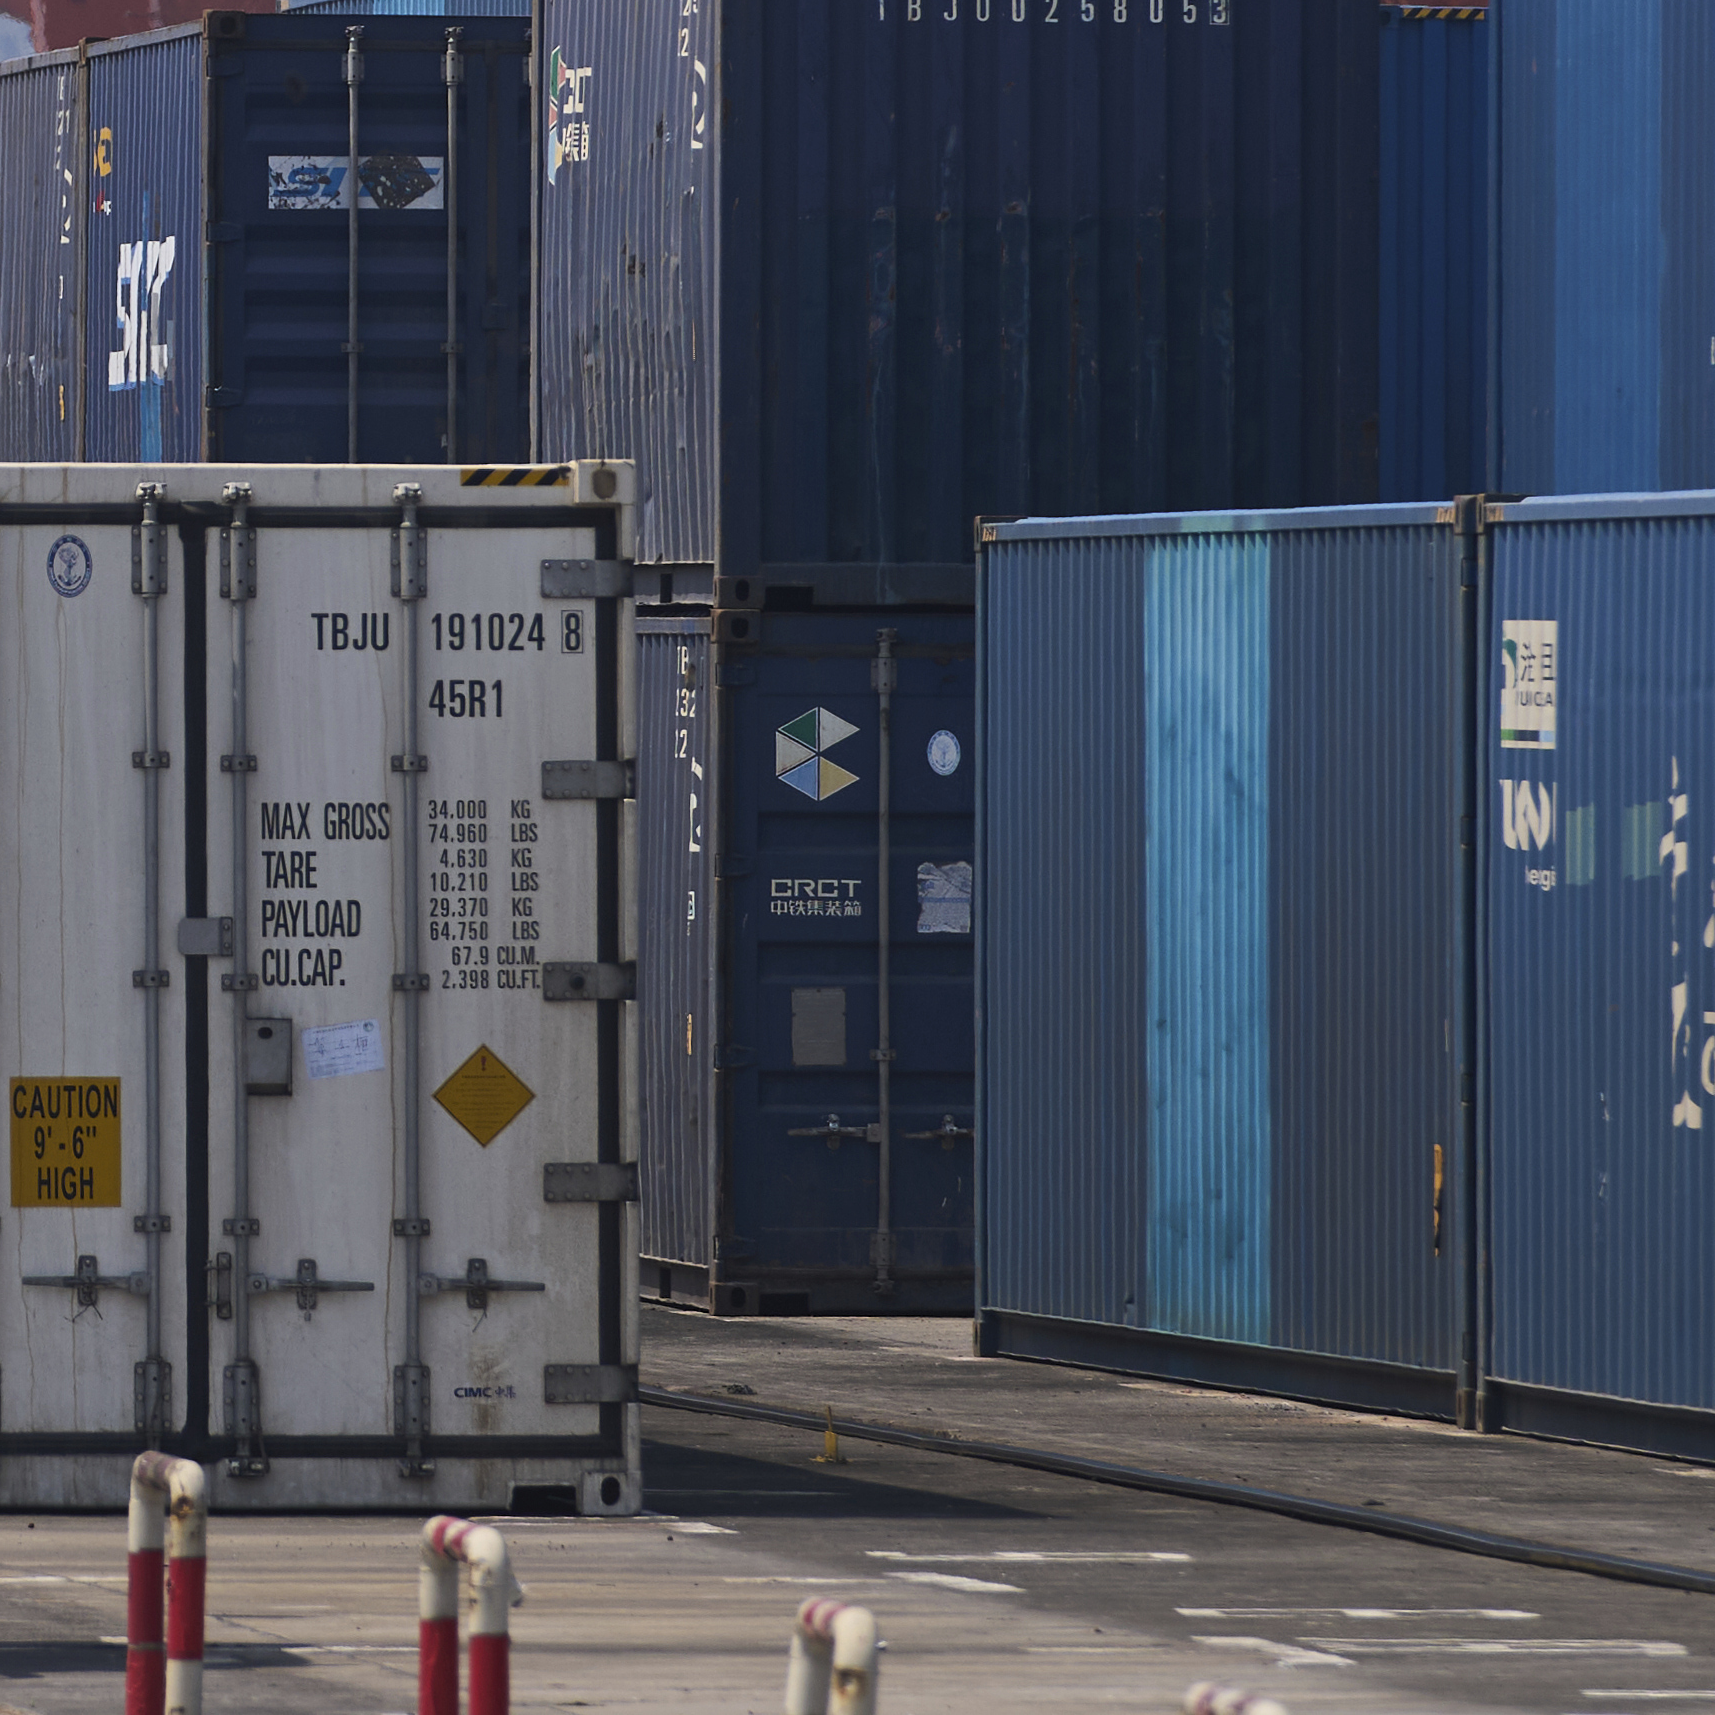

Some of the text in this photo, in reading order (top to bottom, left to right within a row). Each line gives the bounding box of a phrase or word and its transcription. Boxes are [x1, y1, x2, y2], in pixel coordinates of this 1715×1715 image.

[311, 613, 581, 651] TBJU 191024 8
[429, 679, 503, 717] 45R1
[511, 800, 530, 818] KG
[261, 802, 390, 840] MAX GROSS
[511, 823, 538, 842] LBS
[511, 848, 532, 867] KG
[261, 851, 318, 889] TARE
[511, 872, 539, 891] LBS
[771, 879, 862, 898] CRCT
[512, 897, 532, 916] KG
[771, 899, 862, 917] 中铁集装箱
[261, 899, 362, 938] PAYLOAD
[512, 921, 540, 940] LBS
[451, 946, 540, 965] 67.9 CU.M.
[261, 948, 346, 987] CU.CAP.
[497, 969, 541, 989] CU.FT.
[13, 1085, 118, 1119] CAUTION
[37, 1167, 93, 1200] HIGH
[453, 1387, 492, 1399] CIMC
